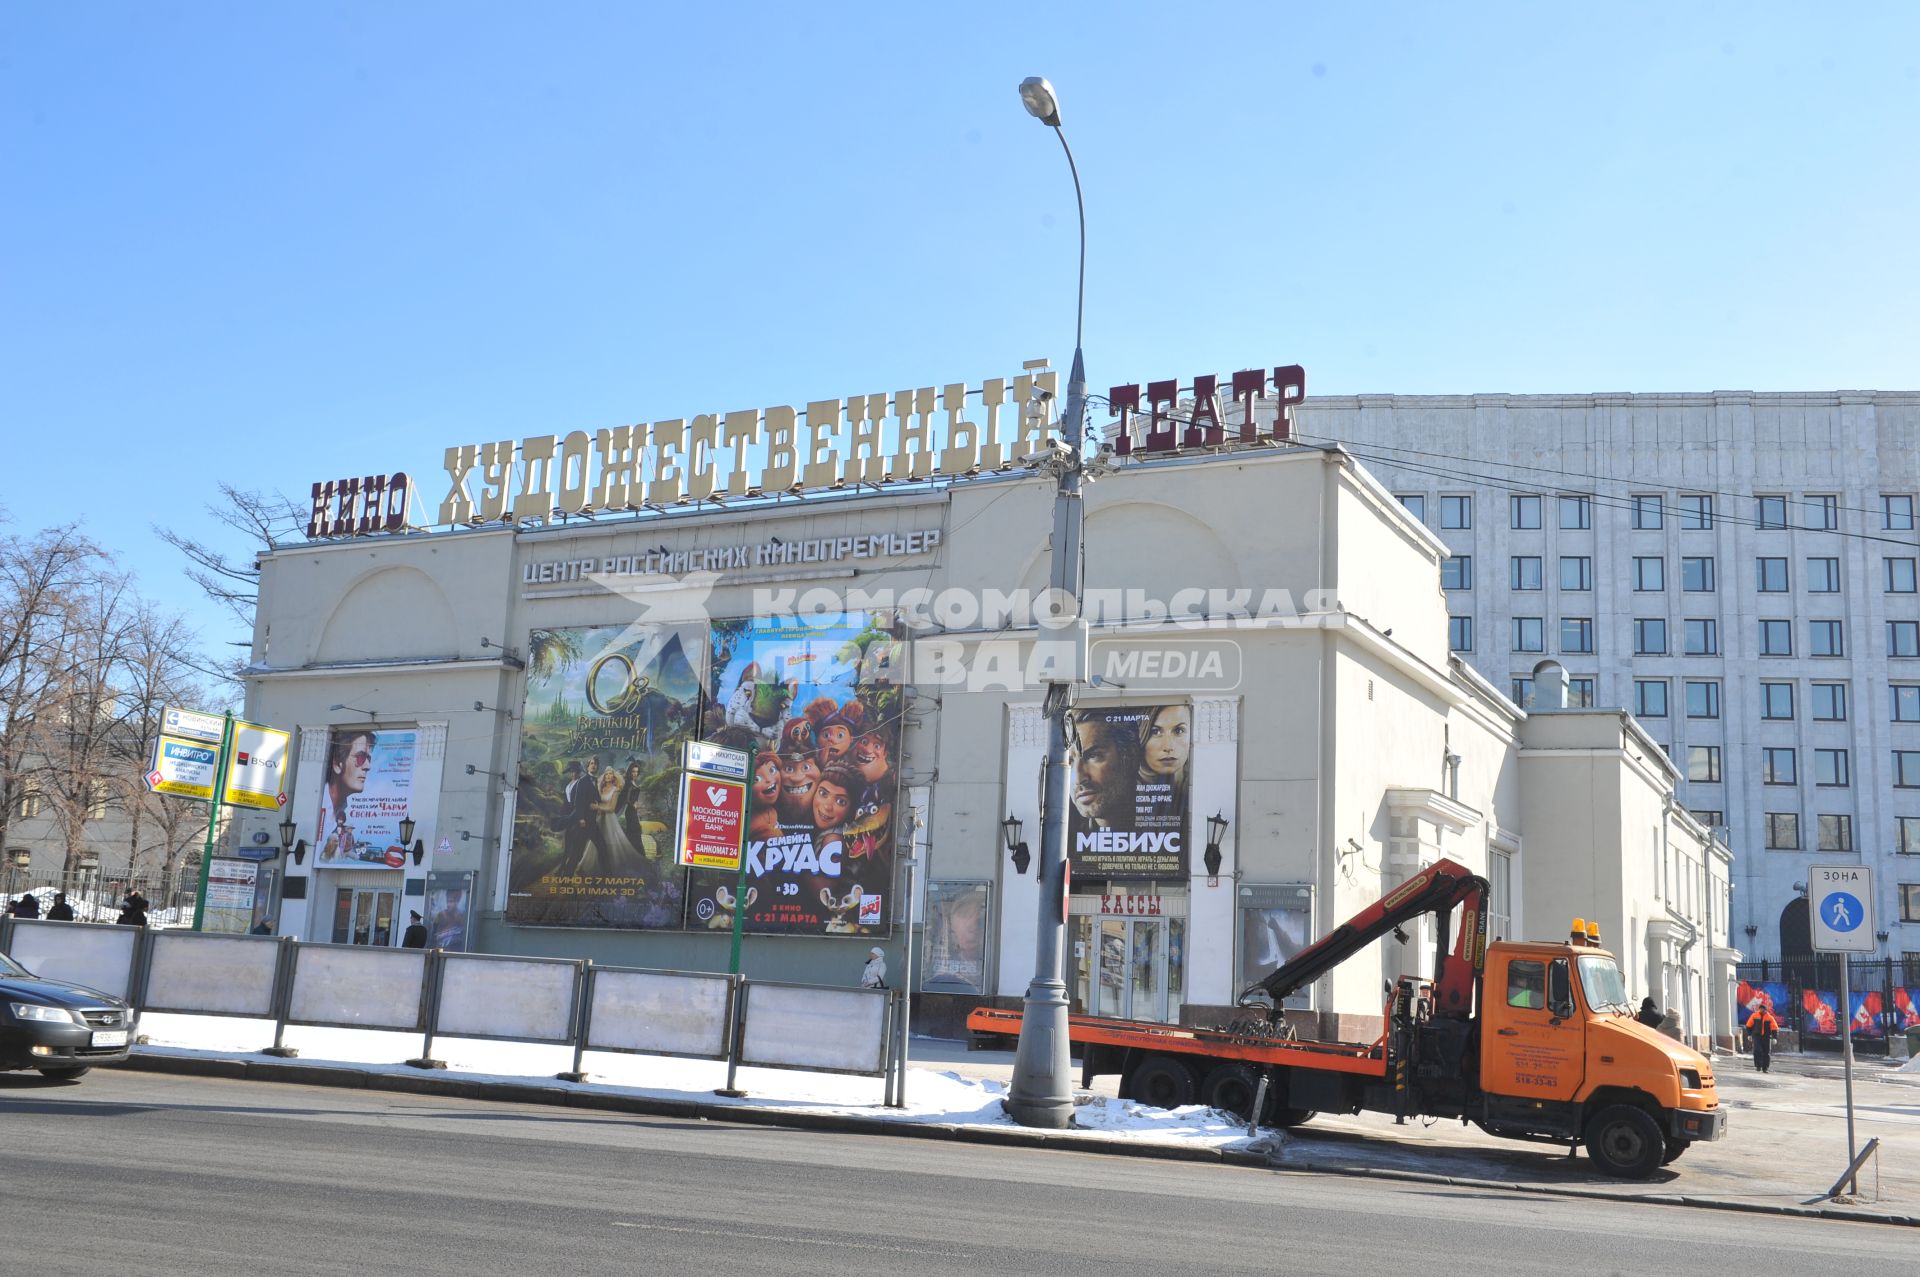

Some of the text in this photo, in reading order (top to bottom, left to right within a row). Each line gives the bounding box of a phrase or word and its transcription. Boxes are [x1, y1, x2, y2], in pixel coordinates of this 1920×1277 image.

[307, 358, 1306, 539] КИНО ХУДОЖЕСТВЕННЫЙ ТЕАТР
[522, 558, 598, 585] ЦЕНТР
[755, 529, 941, 566] КИНОПРЕМЬЕР
[1123, 714, 1151, 722] МАРТА
[170, 746, 209, 761] ИНВИТРО
[251, 757, 280, 769] BSGV
[379, 802, 408, 811] ЧАРЛИ
[691, 806, 739, 818] МОСКОВСКИЙ
[693, 815, 737, 826] КРЕДИТНЫЙ
[704, 823, 724, 832] БАНК
[766, 832, 812, 848] СЕМЕЙКА
[1076, 826, 1181, 853] МЁБИУС
[695, 843, 738, 856] БАНКОМАТ 24
[550, 876, 583, 885] КИНО
[584, 877, 593, 885] С
[595, 877, 602, 886] 7
[605, 878, 645, 886] МАРТА
[1823, 871, 1859, 881] ЗОНА
[549, 887, 636, 896] В 3D И IMAX 3D
[782, 882, 799, 896] 3D
[699, 903, 713, 915] 0+
[1101, 894, 1161, 915] КАССЫ
[754, 914, 761, 922] С
[764, 914, 777, 923] 21
[779, 914, 818, 924] МАРТА
